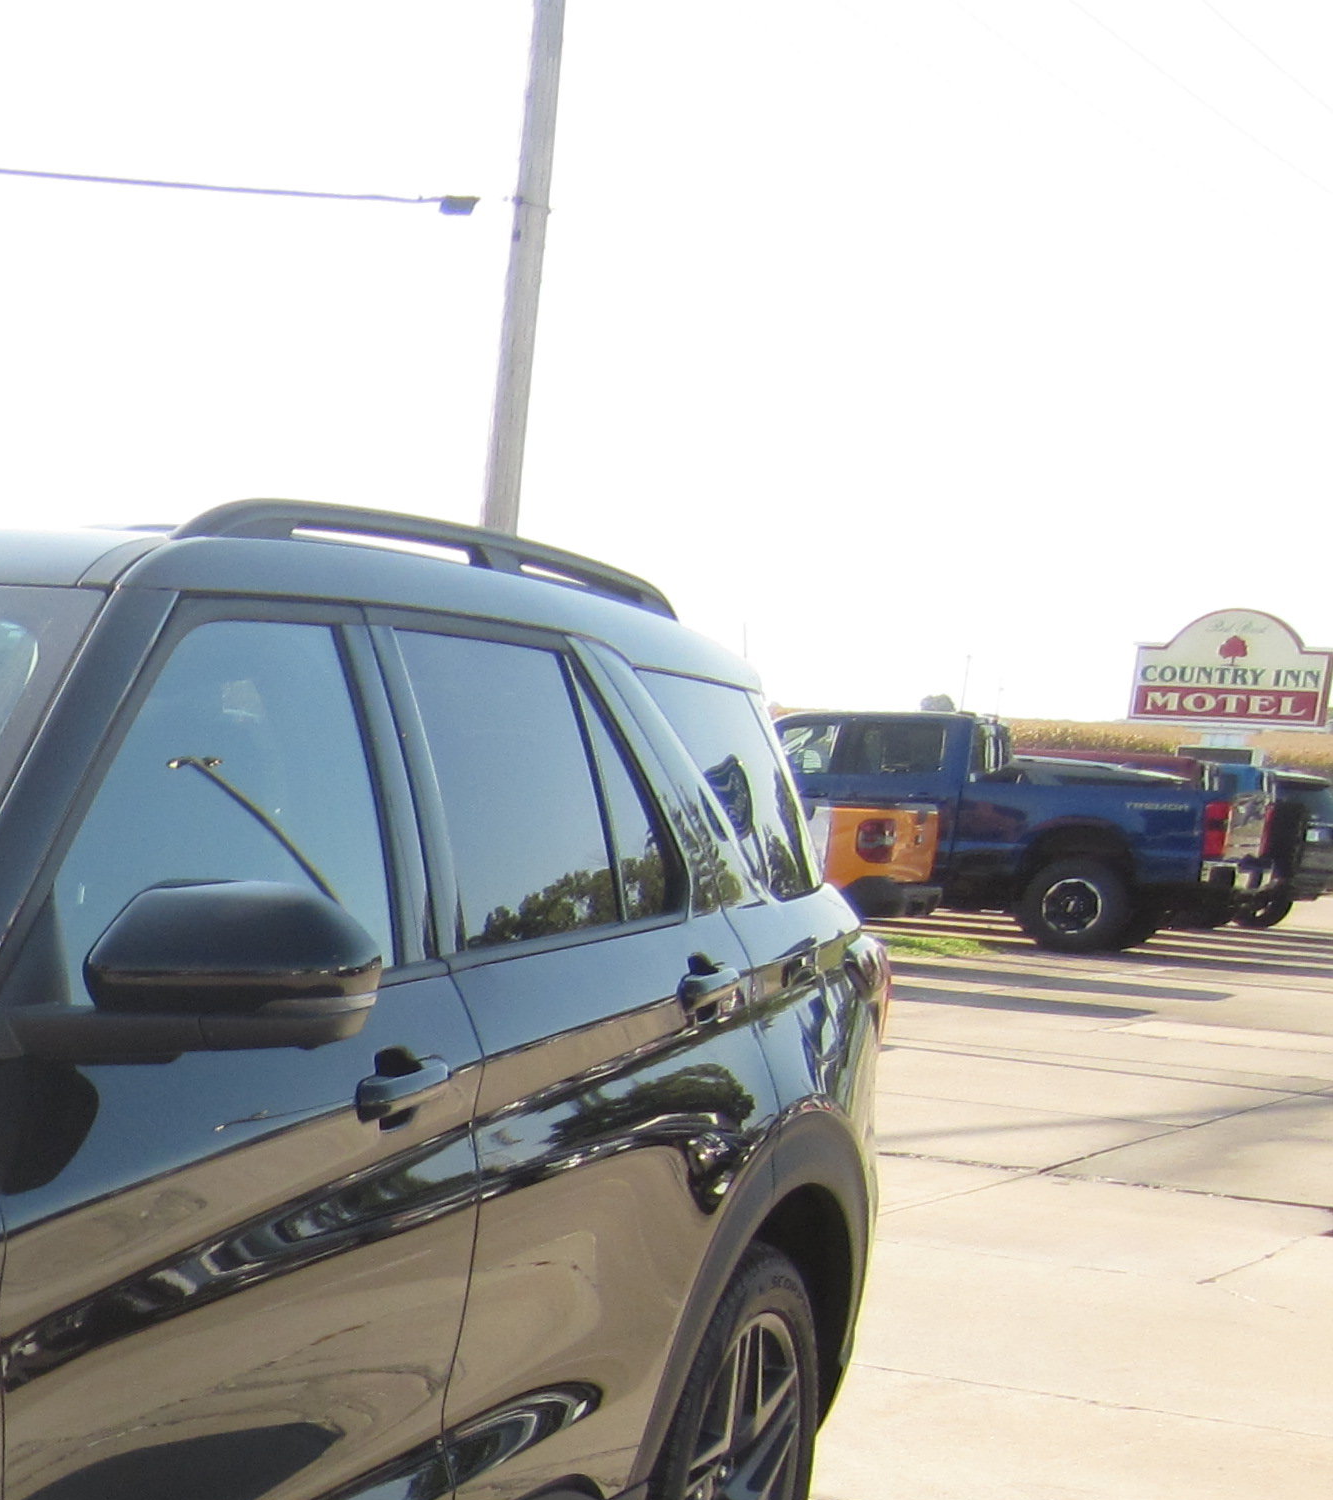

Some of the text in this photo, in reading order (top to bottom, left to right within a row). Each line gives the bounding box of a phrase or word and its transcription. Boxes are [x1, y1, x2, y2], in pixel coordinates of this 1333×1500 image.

[1140, 664, 1321, 688] COUNTRY INN
[1144, 692, 1307, 716] MOTEL
